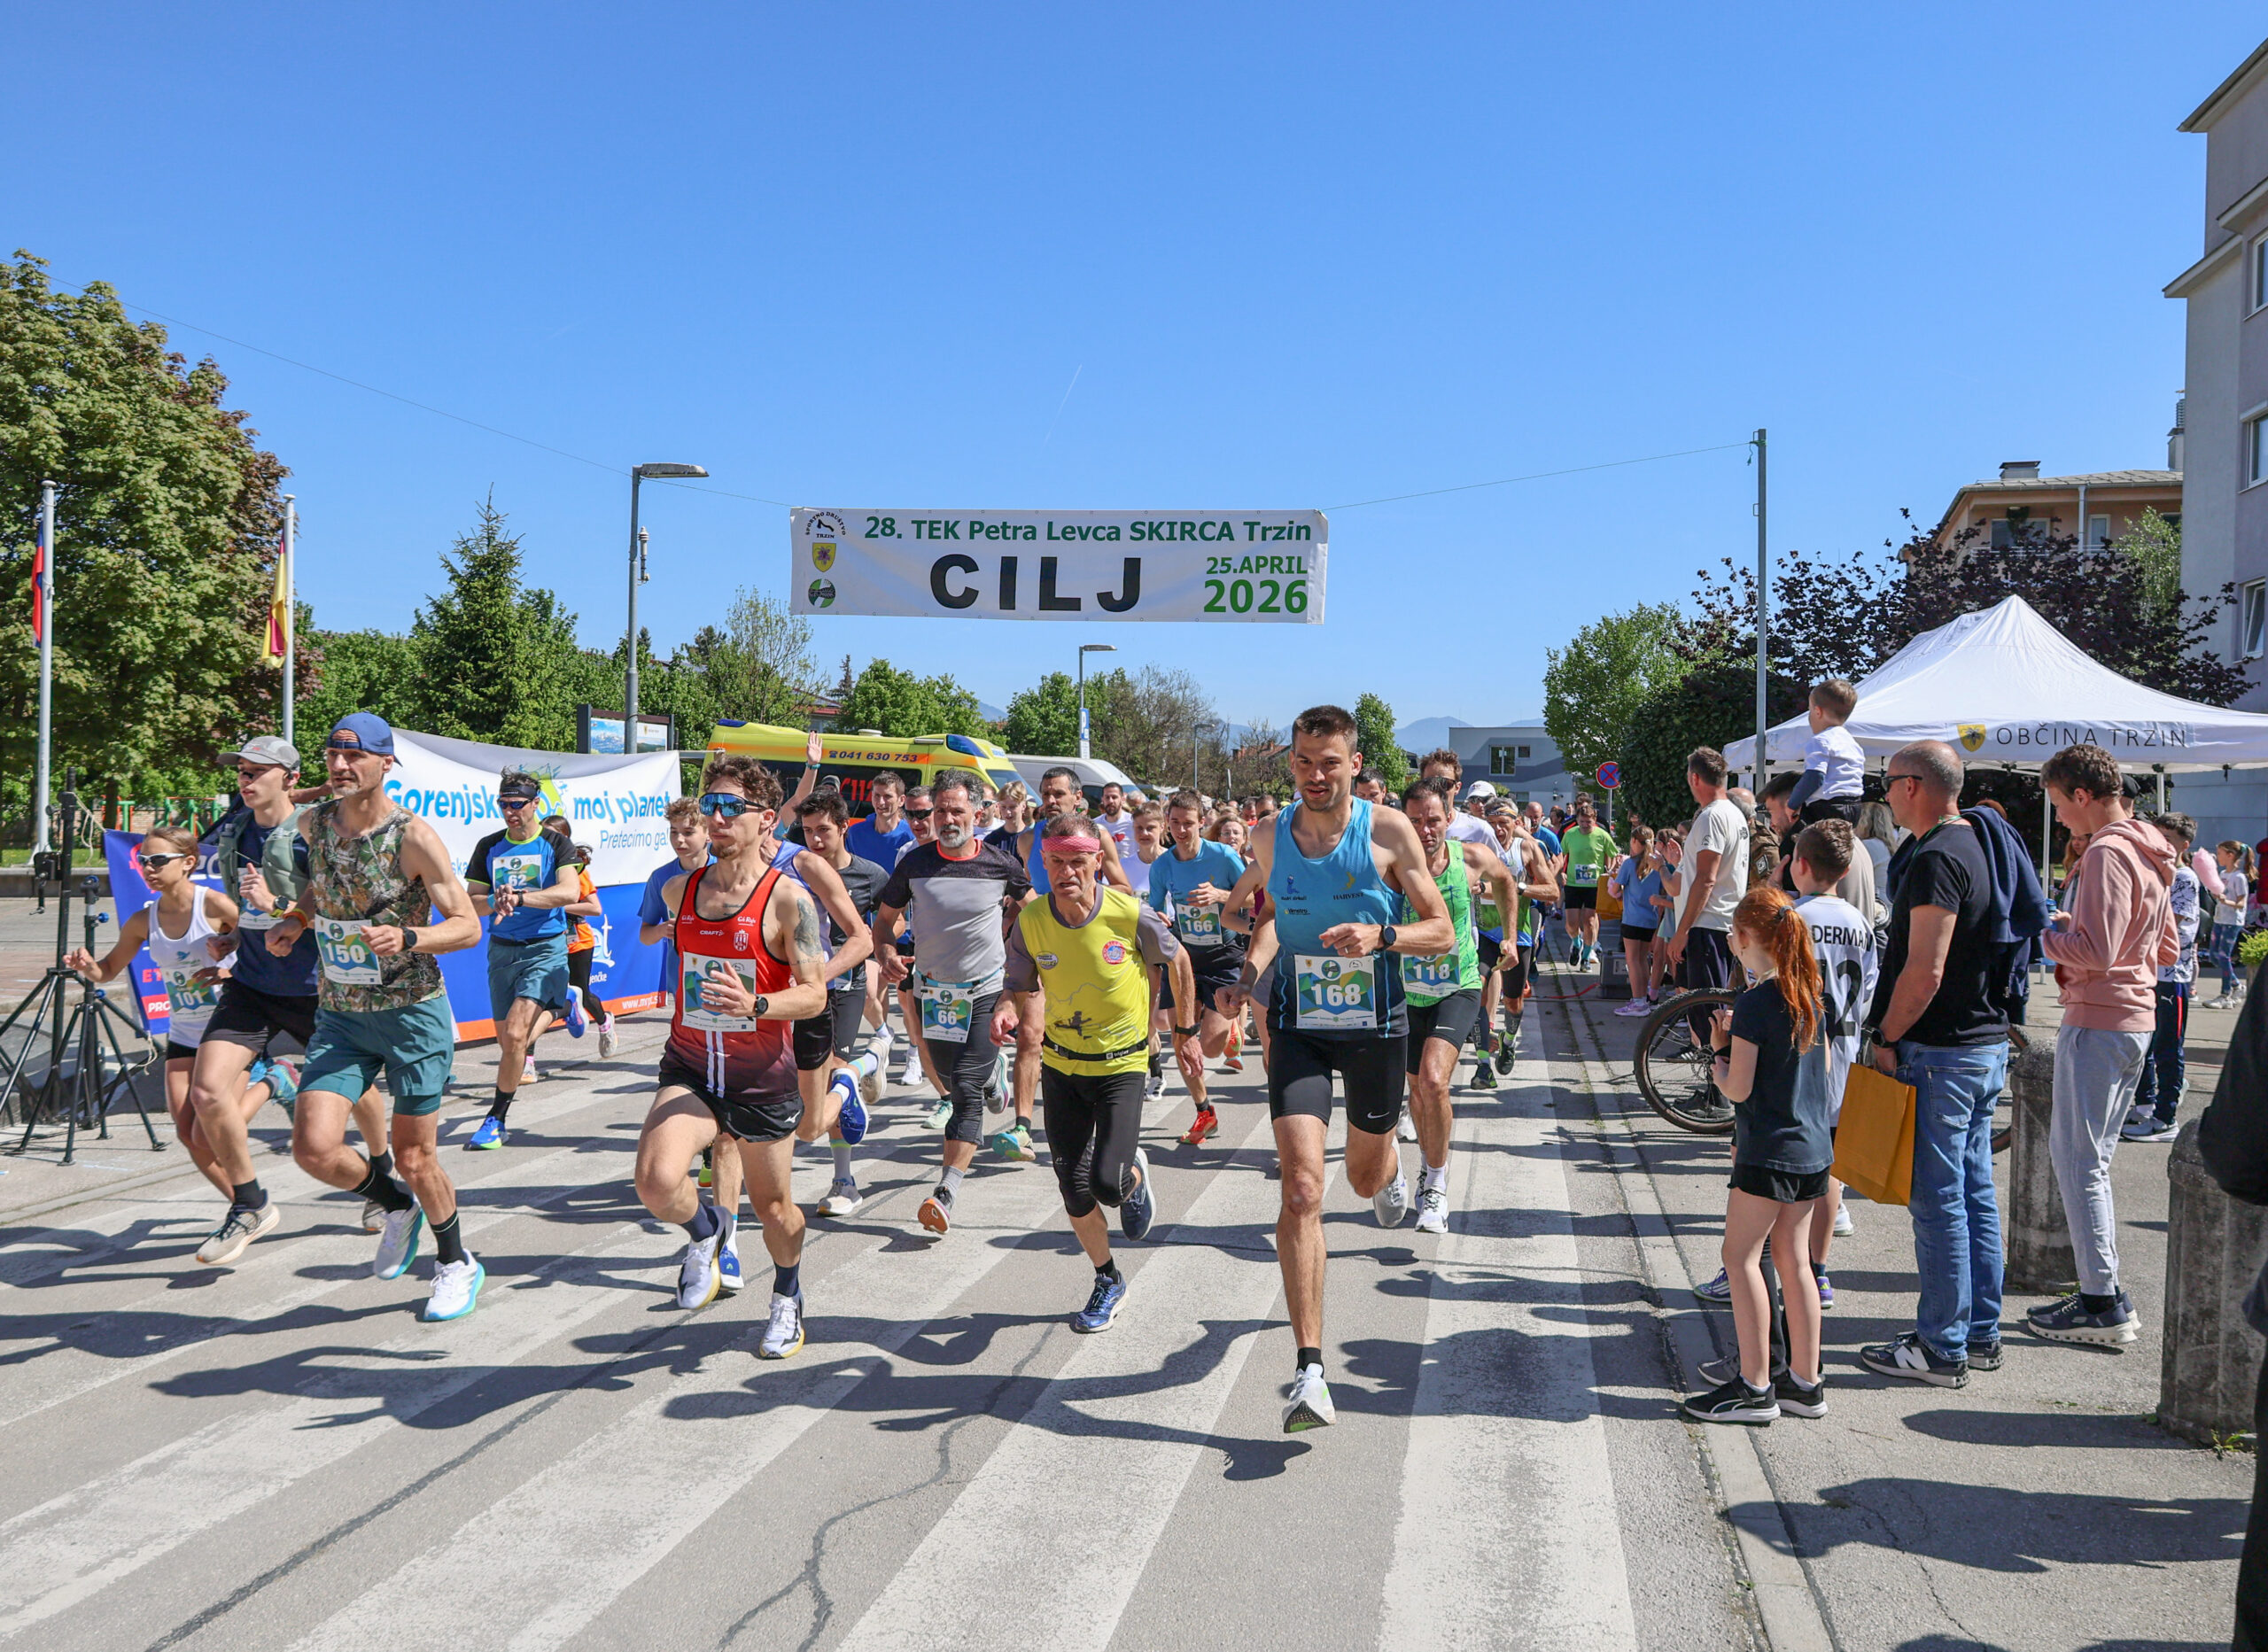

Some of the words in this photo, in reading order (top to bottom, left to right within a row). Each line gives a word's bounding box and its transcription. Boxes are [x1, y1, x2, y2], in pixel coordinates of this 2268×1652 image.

[865, 516, 902, 539] 28.
[911, 520, 961, 539] TEK
[969, 520, 1037, 541] Petra
[1046, 521, 1121, 541] Levca
[1130, 521, 1235, 541] SKIRCA
[1243, 520, 1311, 541] Trzin
[1206, 555, 1308, 575] 25.APRIL
[929, 554, 1141, 612] CILJ
[1203, 579, 1308, 614] 2026
[1996, 723, 2098, 746] OBČINA
[2109, 728, 2186, 748] TRZIN
[839, 751, 862, 760] 041
[866, 752, 890, 761] 630
[894, 754, 918, 763] 753
[384, 779, 505, 826] Gorenjsk
[573, 790, 616, 824] moj
[600, 828, 652, 849] Pretecimo
[654, 827, 670, 851] ga!
[508, 873, 527, 887] 62
[1332, 892, 1363, 901] HARVEST
[1184, 919, 1213, 933] 166
[324, 942, 366, 964] 150
[1413, 963, 1450, 981] 118
[175, 990, 204, 1006] 101
[1311, 983, 1362, 1006] 168
[937, 1010, 957, 1026] 66
